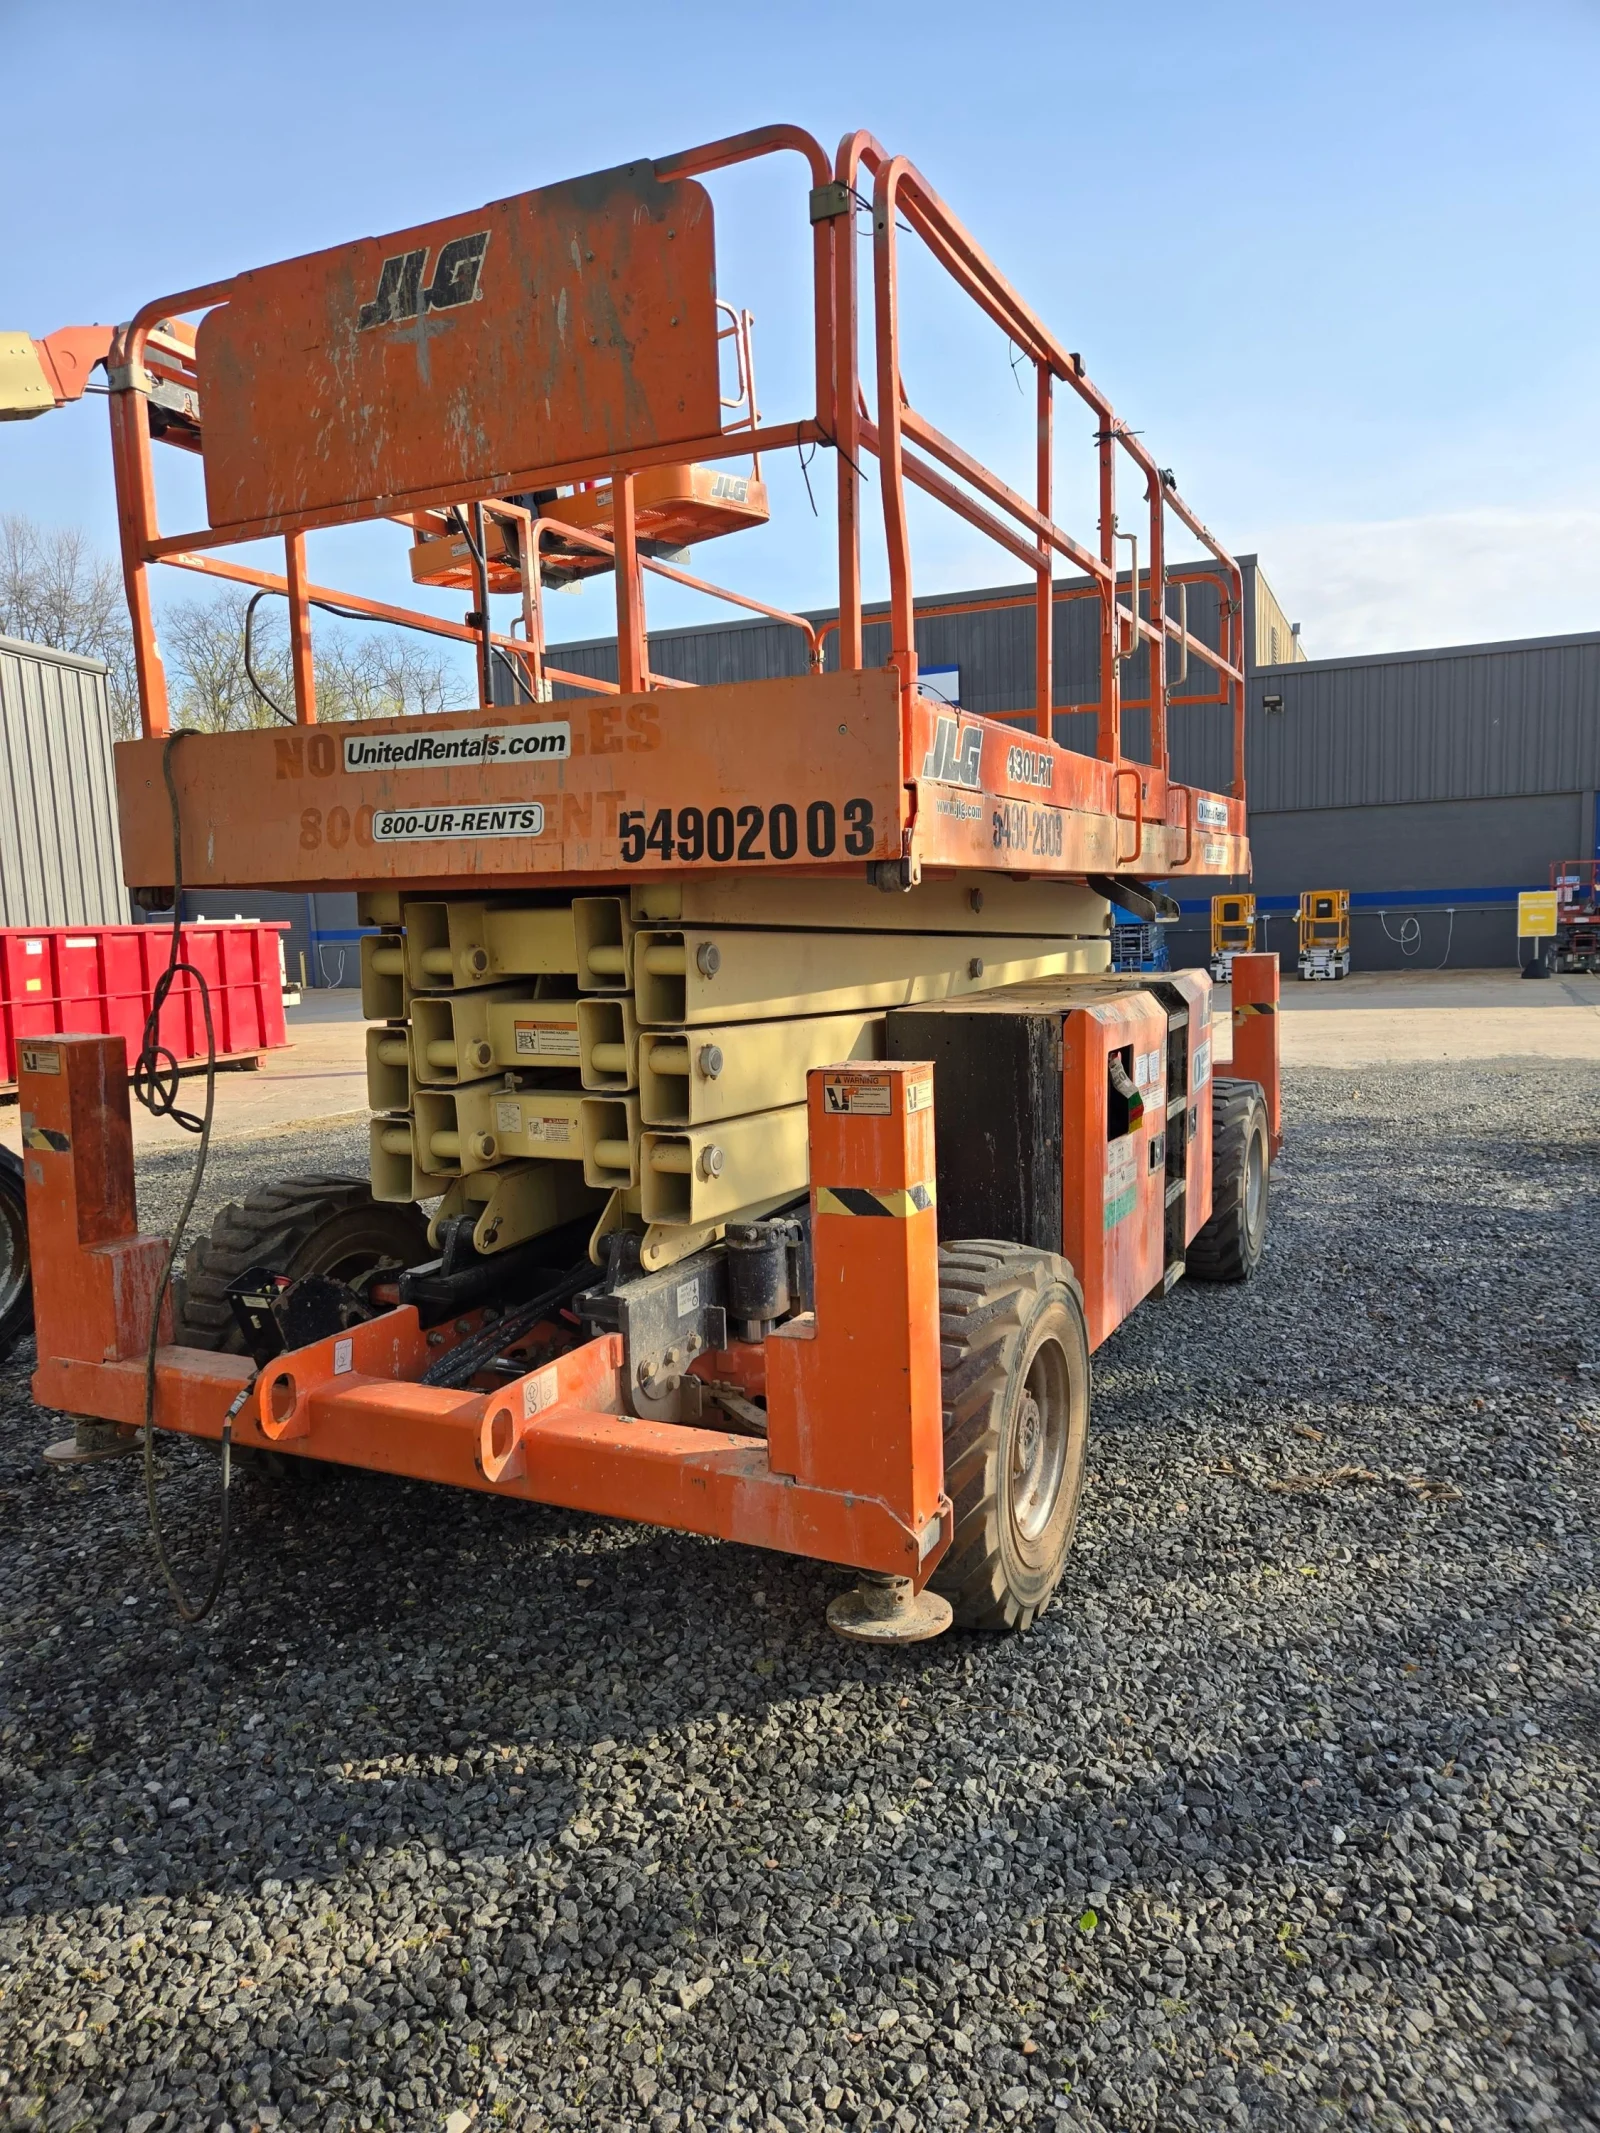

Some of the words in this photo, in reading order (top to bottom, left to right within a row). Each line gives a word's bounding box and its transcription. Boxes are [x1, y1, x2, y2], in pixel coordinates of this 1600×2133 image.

[355, 230, 491, 333] JLG
[711, 476, 748, 503] JLG
[347, 733, 566, 765] UnitedRentals.com
[922, 716, 983, 787] JLG
[1007, 745, 1054, 788] 430LRT
[380, 809, 535, 835] 800-UR-RENTS
[936, 800, 982, 820] www.jlg.com
[619, 798, 875, 863] 54902003
[843, 1076, 879, 1085] WARNING
